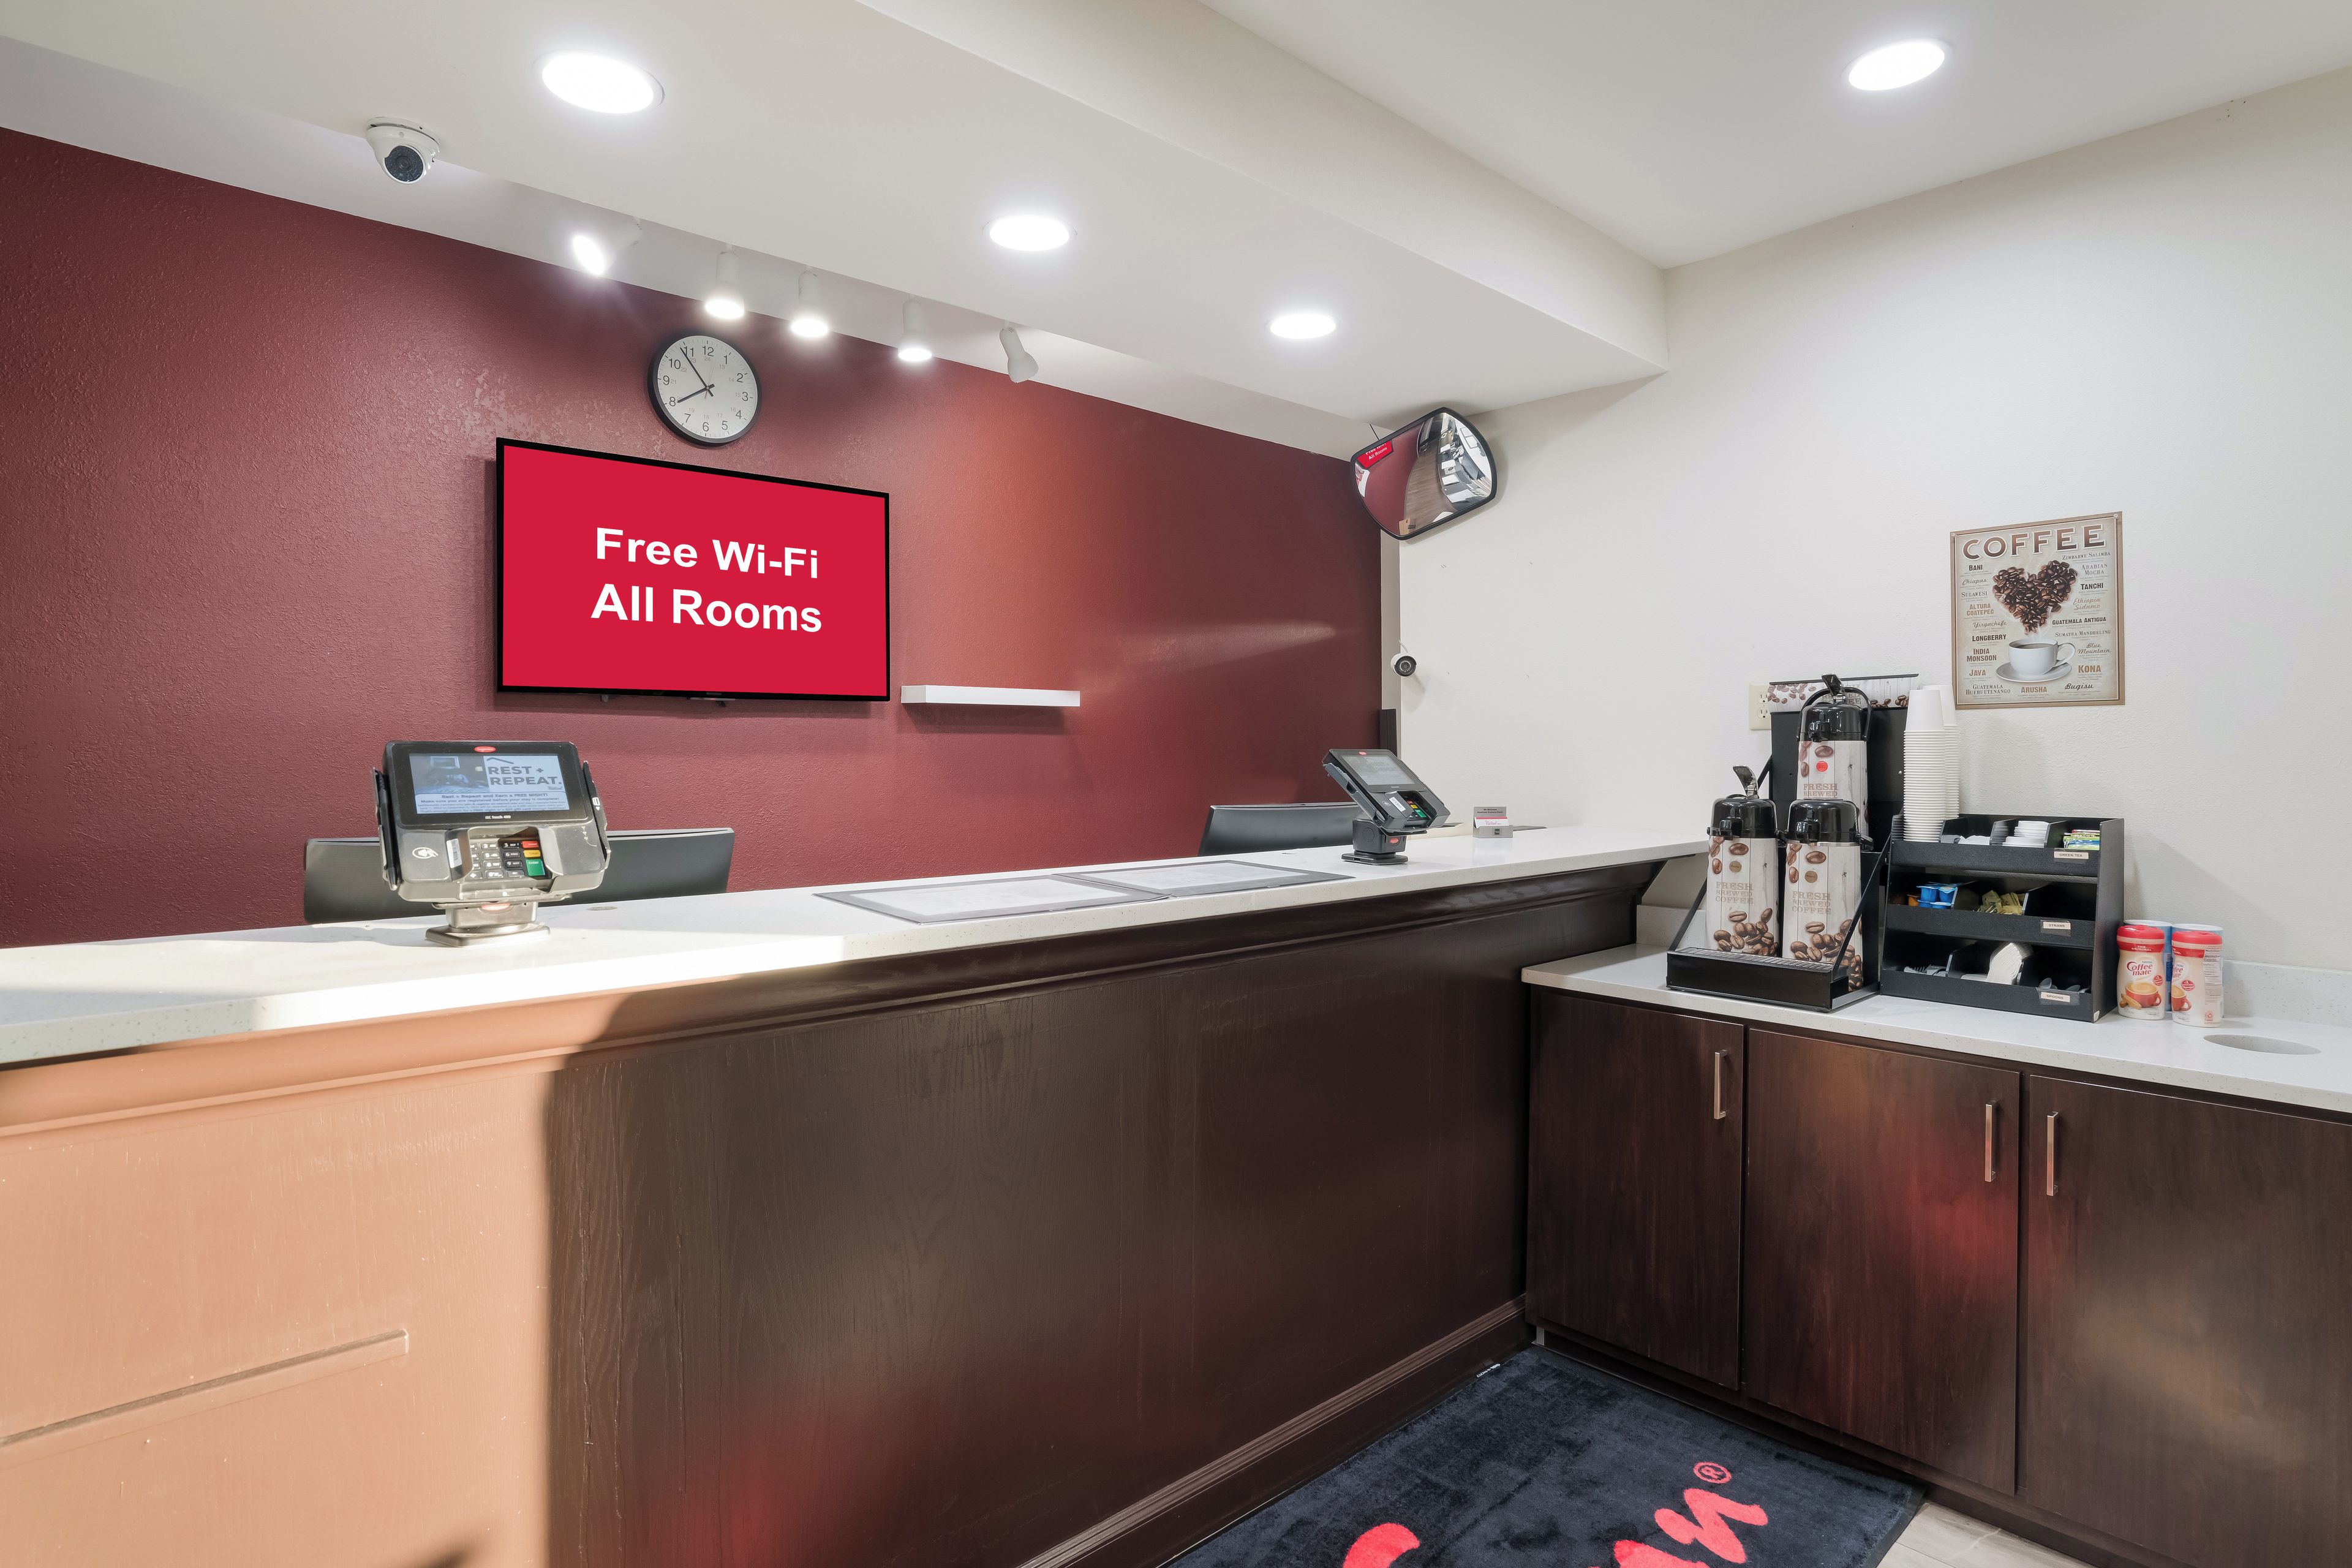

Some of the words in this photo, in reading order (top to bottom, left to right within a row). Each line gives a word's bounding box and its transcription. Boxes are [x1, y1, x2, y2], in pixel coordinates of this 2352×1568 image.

[684, 345, 695, 357] 11
[702, 345, 714, 356] 12
[668, 358, 681, 369] 10
[723, 355, 728, 364] 1
[663, 375, 669, 385] 9
[737, 373, 744, 383] 2
[669, 396, 676, 407] 8
[742, 391, 748, 402] 3
[684, 413, 691, 423] 7
[735, 410, 742, 419] 4
[702, 421, 709, 431] 6
[722, 421, 728, 430] 5
[1962, 524, 2106, 560] COFFEE
[596, 527, 698, 568] Free
[712, 540, 818, 579] Wi-Fi
[591, 584, 654, 622] All
[673, 589, 822, 633] Rooms
[2078, 665, 2101, 673] KONA
[2064, 682, 2094, 691] Bugisu
[488, 766, 532, 775] REST
[489, 776, 562, 785] REPEAT.
[1716, 882, 1754, 891] FRESH
[1792, 891, 1831, 900] FRESH
[1792, 906, 1831, 914] COFFEE
[2127, 961, 2153, 971] Coffee
